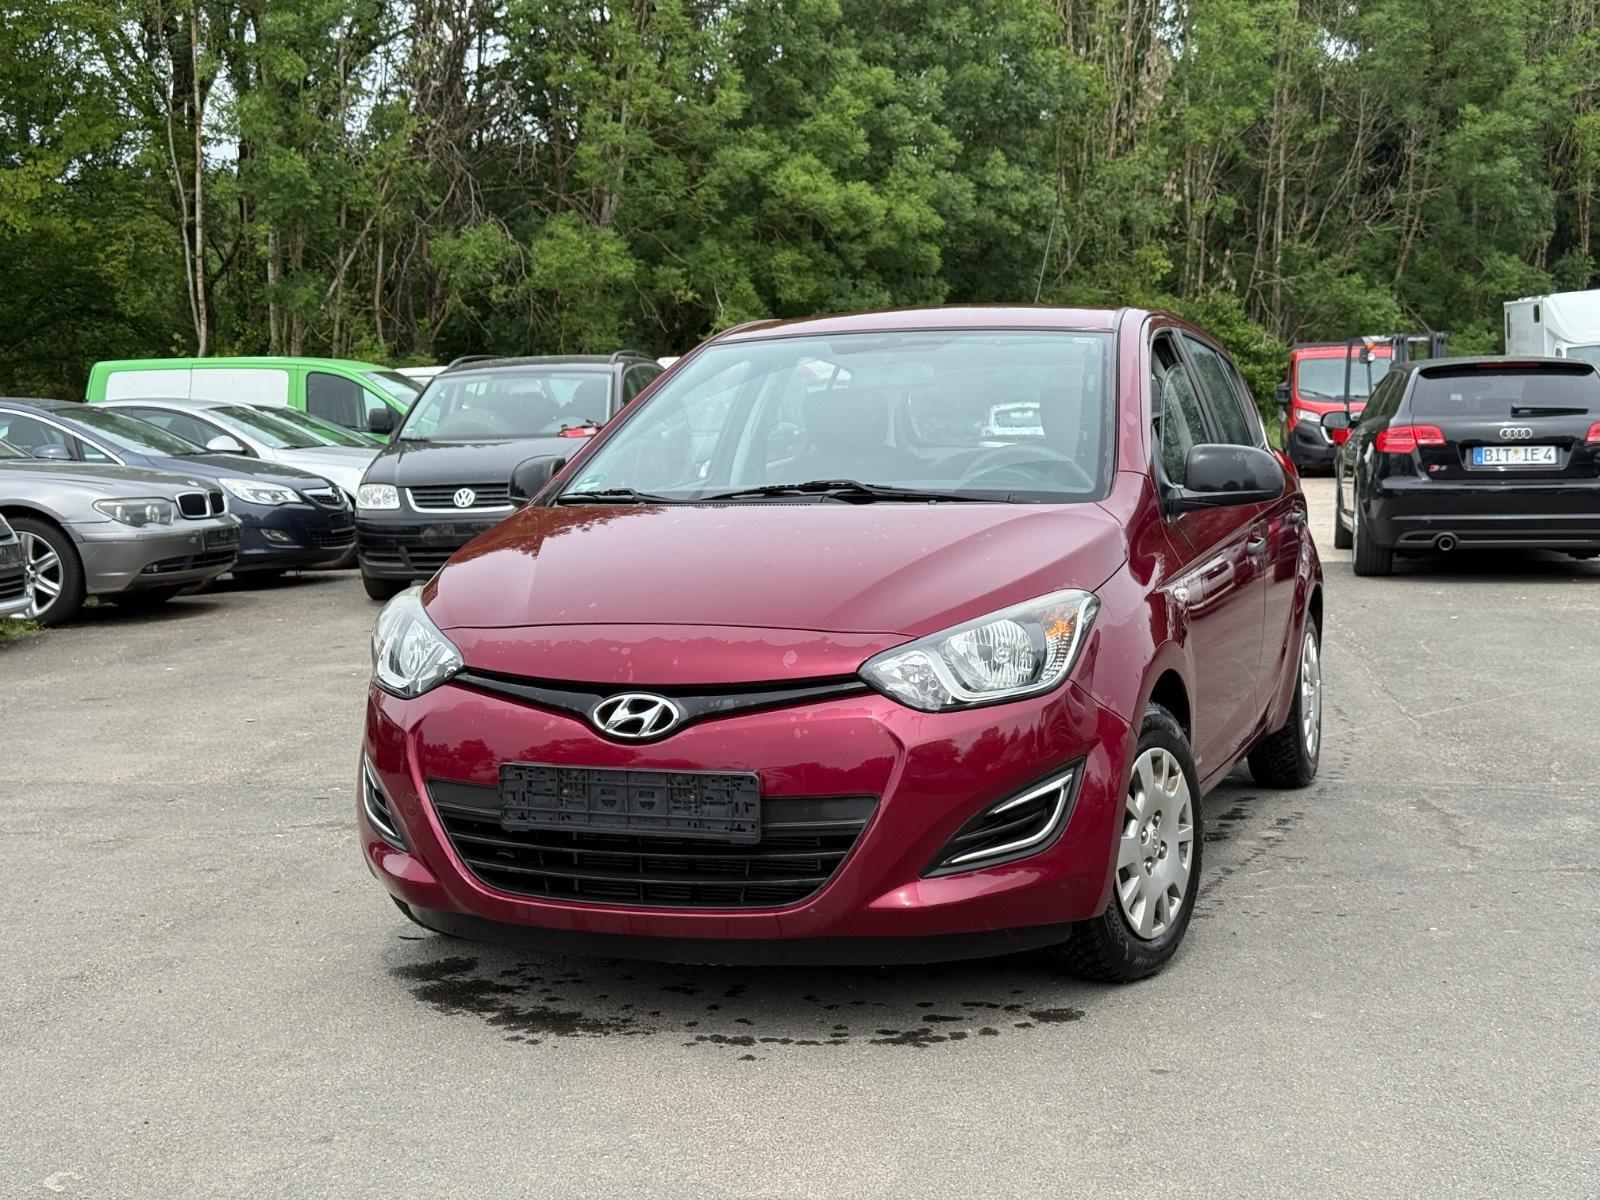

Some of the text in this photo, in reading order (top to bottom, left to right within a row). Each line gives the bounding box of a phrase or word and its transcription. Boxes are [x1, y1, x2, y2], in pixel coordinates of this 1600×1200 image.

[1484, 447, 1553, 462] BIT IE 4
